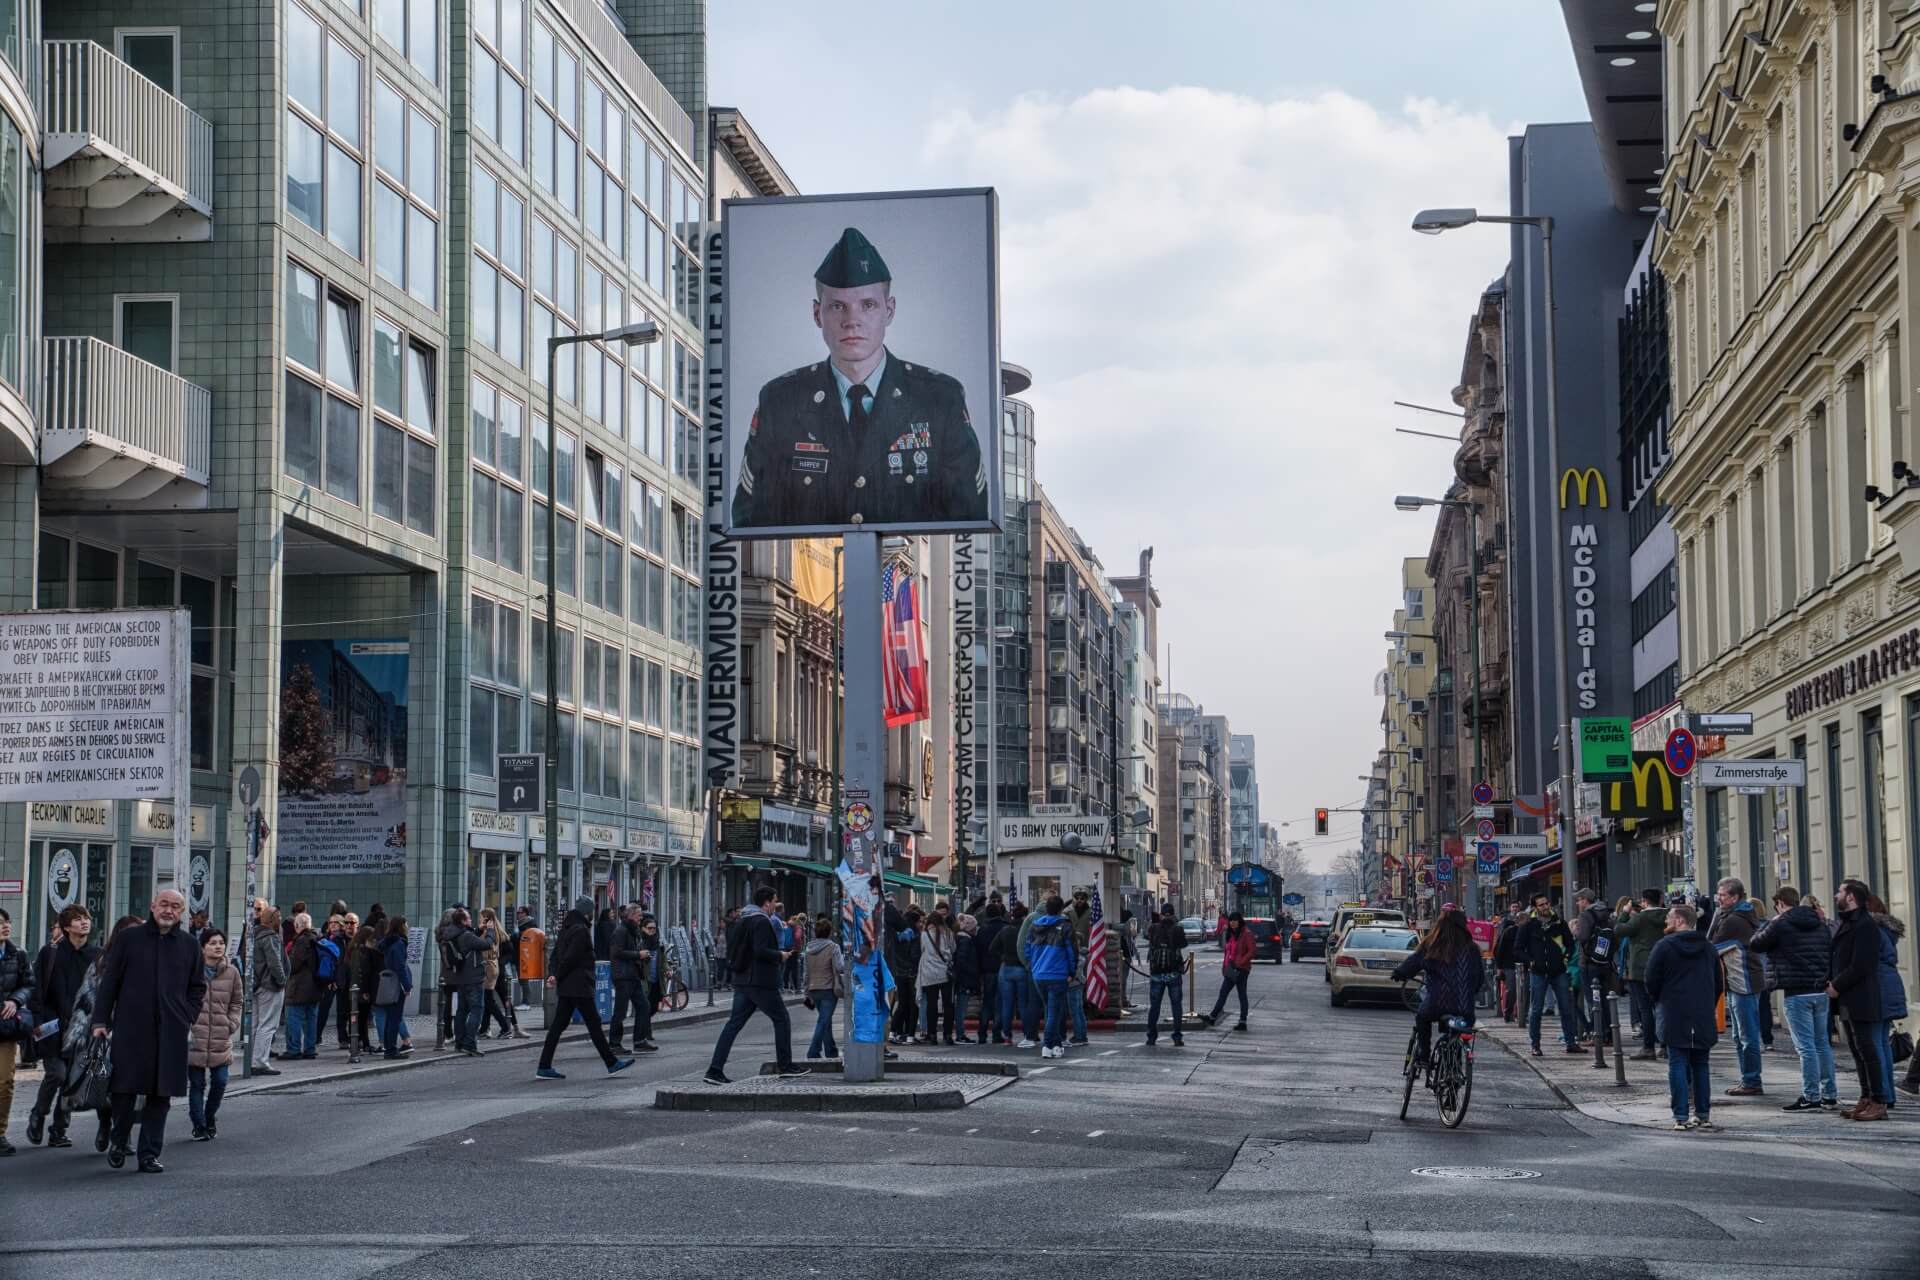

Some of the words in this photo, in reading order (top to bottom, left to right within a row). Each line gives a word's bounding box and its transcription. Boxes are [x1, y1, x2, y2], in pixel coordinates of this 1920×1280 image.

[9, 624, 51, 636] ENTERING
[56, 623, 70, 634] THE
[75, 622, 121, 634] AMERICAN
[126, 621, 160, 633] SECTOR
[13, 638, 57, 650] WEAPONS
[61, 637, 78, 649] OFF
[83, 637, 106, 649] DUTY
[110, 635, 160, 648] FORBIDDEN
[13, 653, 37, 665] OBEY
[42, 652, 79, 664] TRAFFIC
[84, 650, 111, 663] RULES
[708, 523, 738, 778] MAUERMUSEUM
[955, 599, 972, 735] CHECKPOINT
[1785, 664, 1846, 720] EINSTEIN
[1856, 627, 1920, 691] KAFFEE
[126, 669, 159, 681] СЕКТОР
[140, 683, 165, 695] ВРЕМЯ
[40, 699, 95, 712] ДОРОЖНЫМ
[101, 698, 151, 710] ПРАВИЛАМ
[27, 721, 51, 733] DANS
[56, 721, 64, 732] LE
[70, 720, 109, 732] SECTEUR
[3, 737, 30, 749] PORTER
[32, 736, 47, 747] DES
[49, 736, 73, 747] ARMES
[76, 735, 86, 747] EN
[89, 734, 119, 746] DEHORS
[122, 734, 132, 745] DU
[135, 732, 166, 744] SERVICE
[1585, 734, 1597, 742] OF
[1600, 734, 1624, 742] SPIES
[19, 752, 37, 763] AUX
[81, 749, 91, 760] DE
[96, 747, 154, 760] CIRCULATION
[955, 744, 972, 778] AM
[25, 771, 42, 784] DEN
[47, 768, 125, 783] AMERIKANISCHEN
[130, 766, 164, 779] SEKTOR
[1714, 765, 1787, 780] Zimmerstraße
[74, 806, 106, 825] CHARLIE
[148, 813, 174, 831] MUSEUM
[1004, 824, 1018, 837] US
[1022, 823, 1047, 837] ARMY
[1050, 823, 1104, 837] CHECKPOINT
[1480, 864, 1498, 872] TAXI
